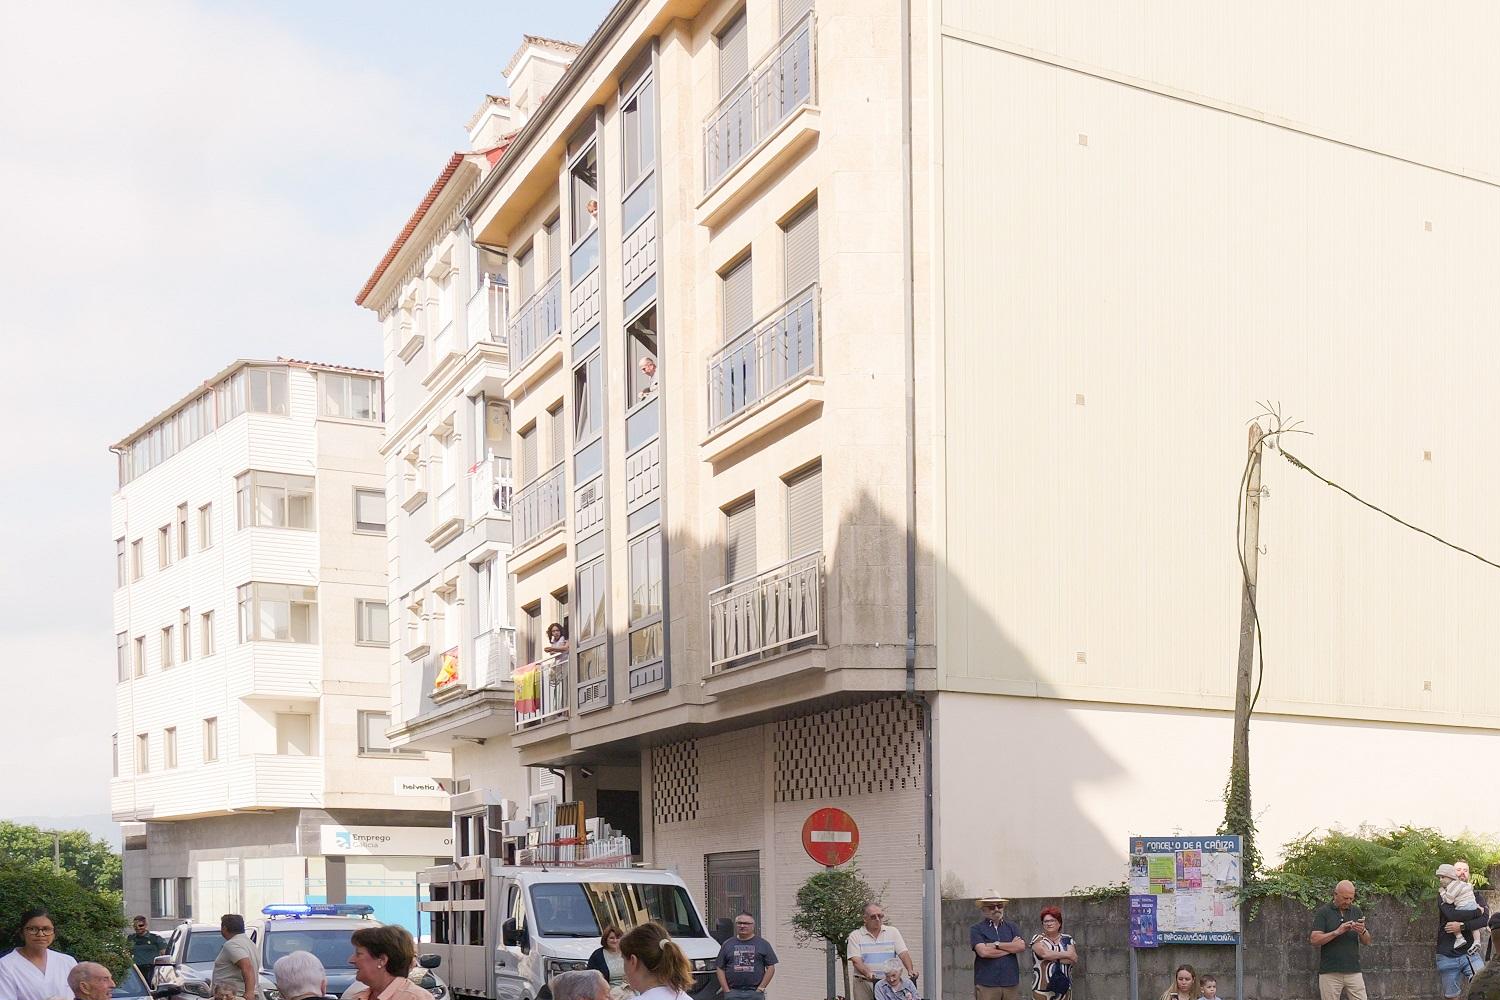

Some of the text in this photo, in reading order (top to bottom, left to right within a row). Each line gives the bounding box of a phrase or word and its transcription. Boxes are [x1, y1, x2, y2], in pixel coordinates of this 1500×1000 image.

[402, 783, 435, 791] helvetia
[352, 833, 391, 843] Emprego
[1183, 841, 1194, 849] DE
[1196, 841, 1202, 849] A
[1204, 840, 1235, 849] CAÑIZA
